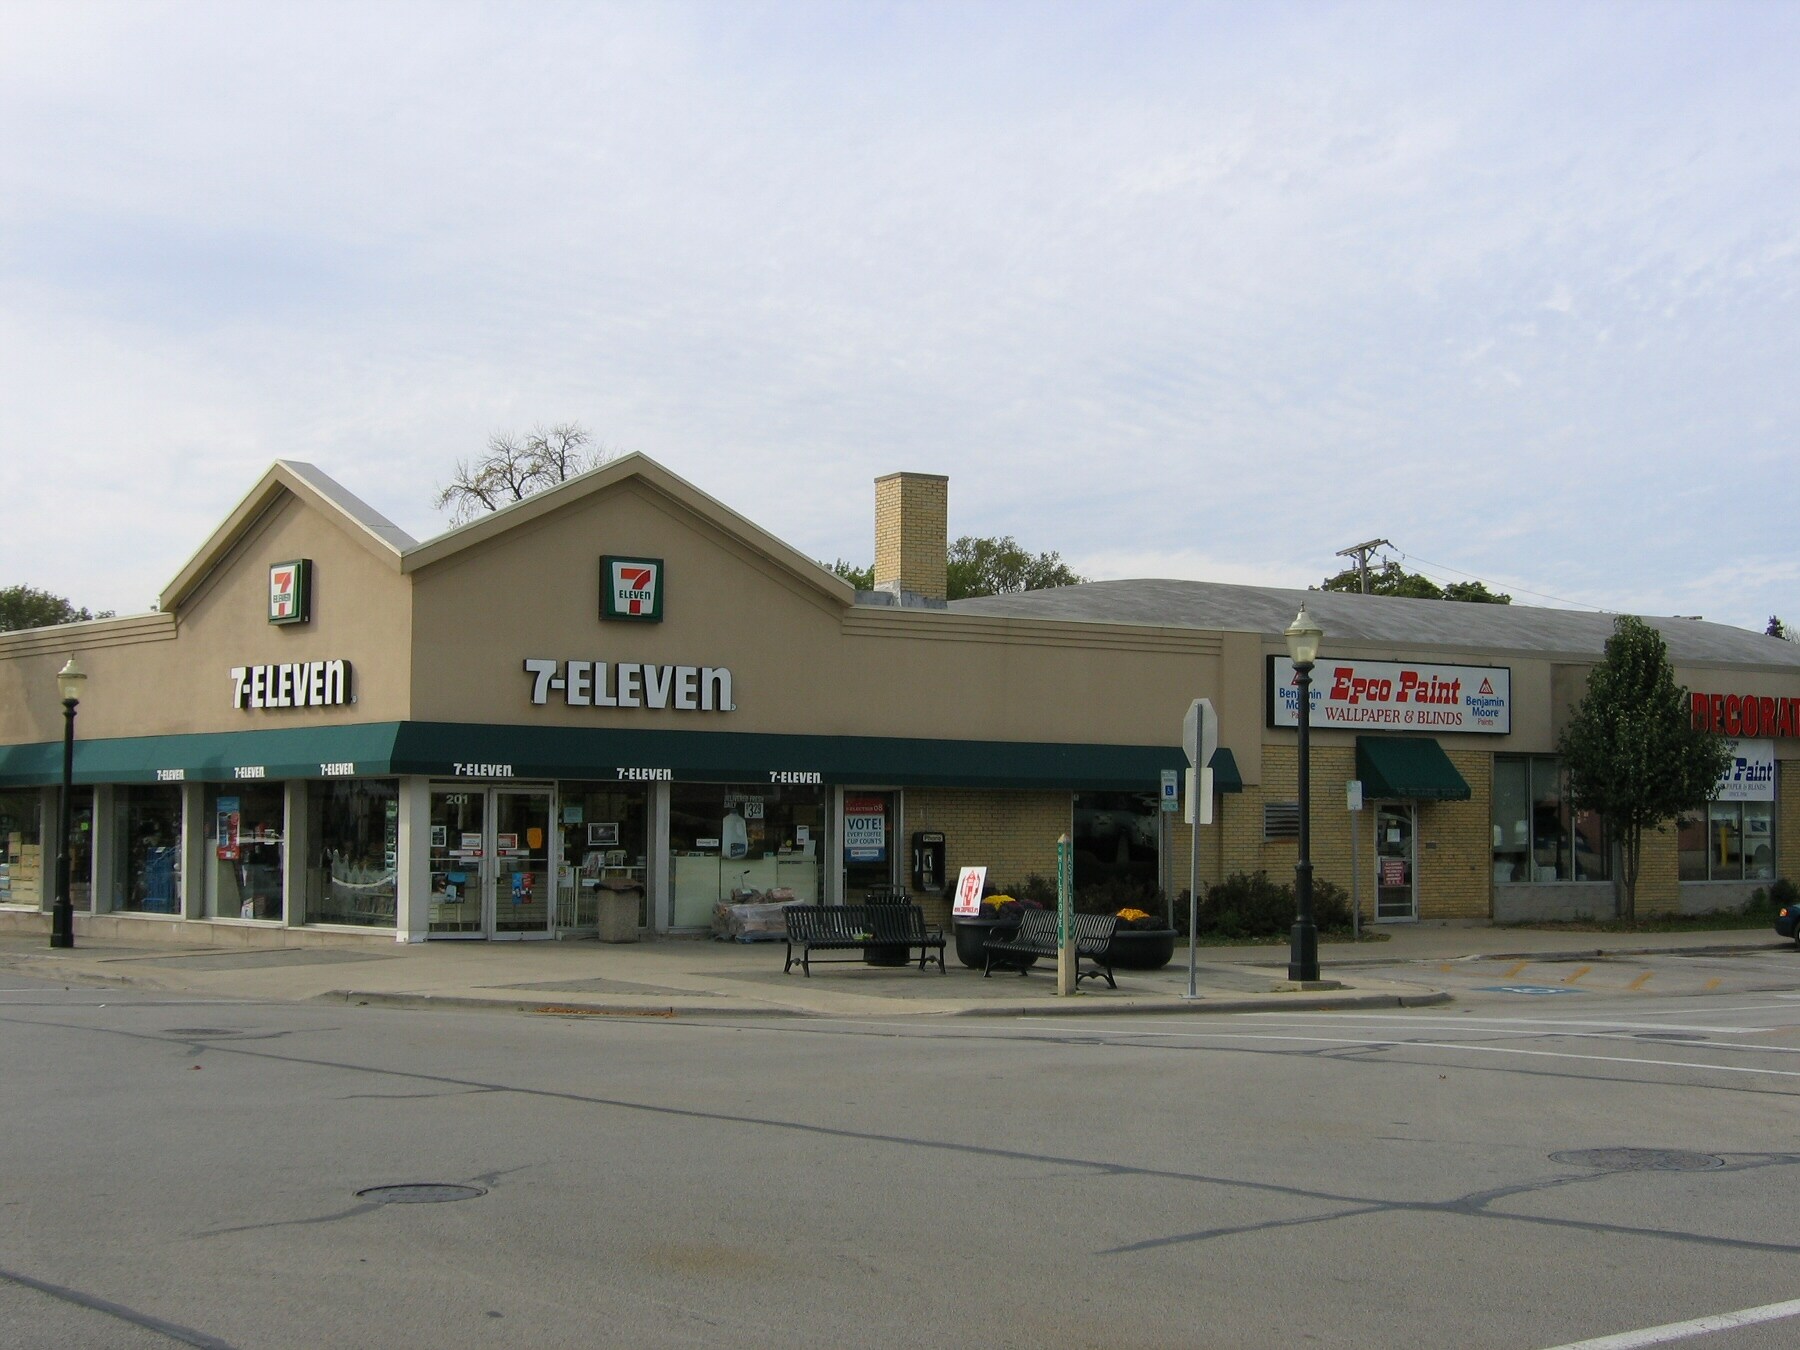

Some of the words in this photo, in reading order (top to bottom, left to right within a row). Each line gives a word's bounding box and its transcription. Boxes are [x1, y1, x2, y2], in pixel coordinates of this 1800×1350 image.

[1395, 671, 1460, 704] Paint
[1466, 695, 1505, 708] Benjamin
[1325, 707, 1401, 723] WALLPAPER
[1404, 710, 1414, 723] &
[1417, 710, 1463, 725] BLINDS
[1472, 707, 1499, 717] Moore
[1734, 758, 1772, 781] Paint
[446, 794, 468, 805] 201
[848, 818, 882, 830] VOTE!
